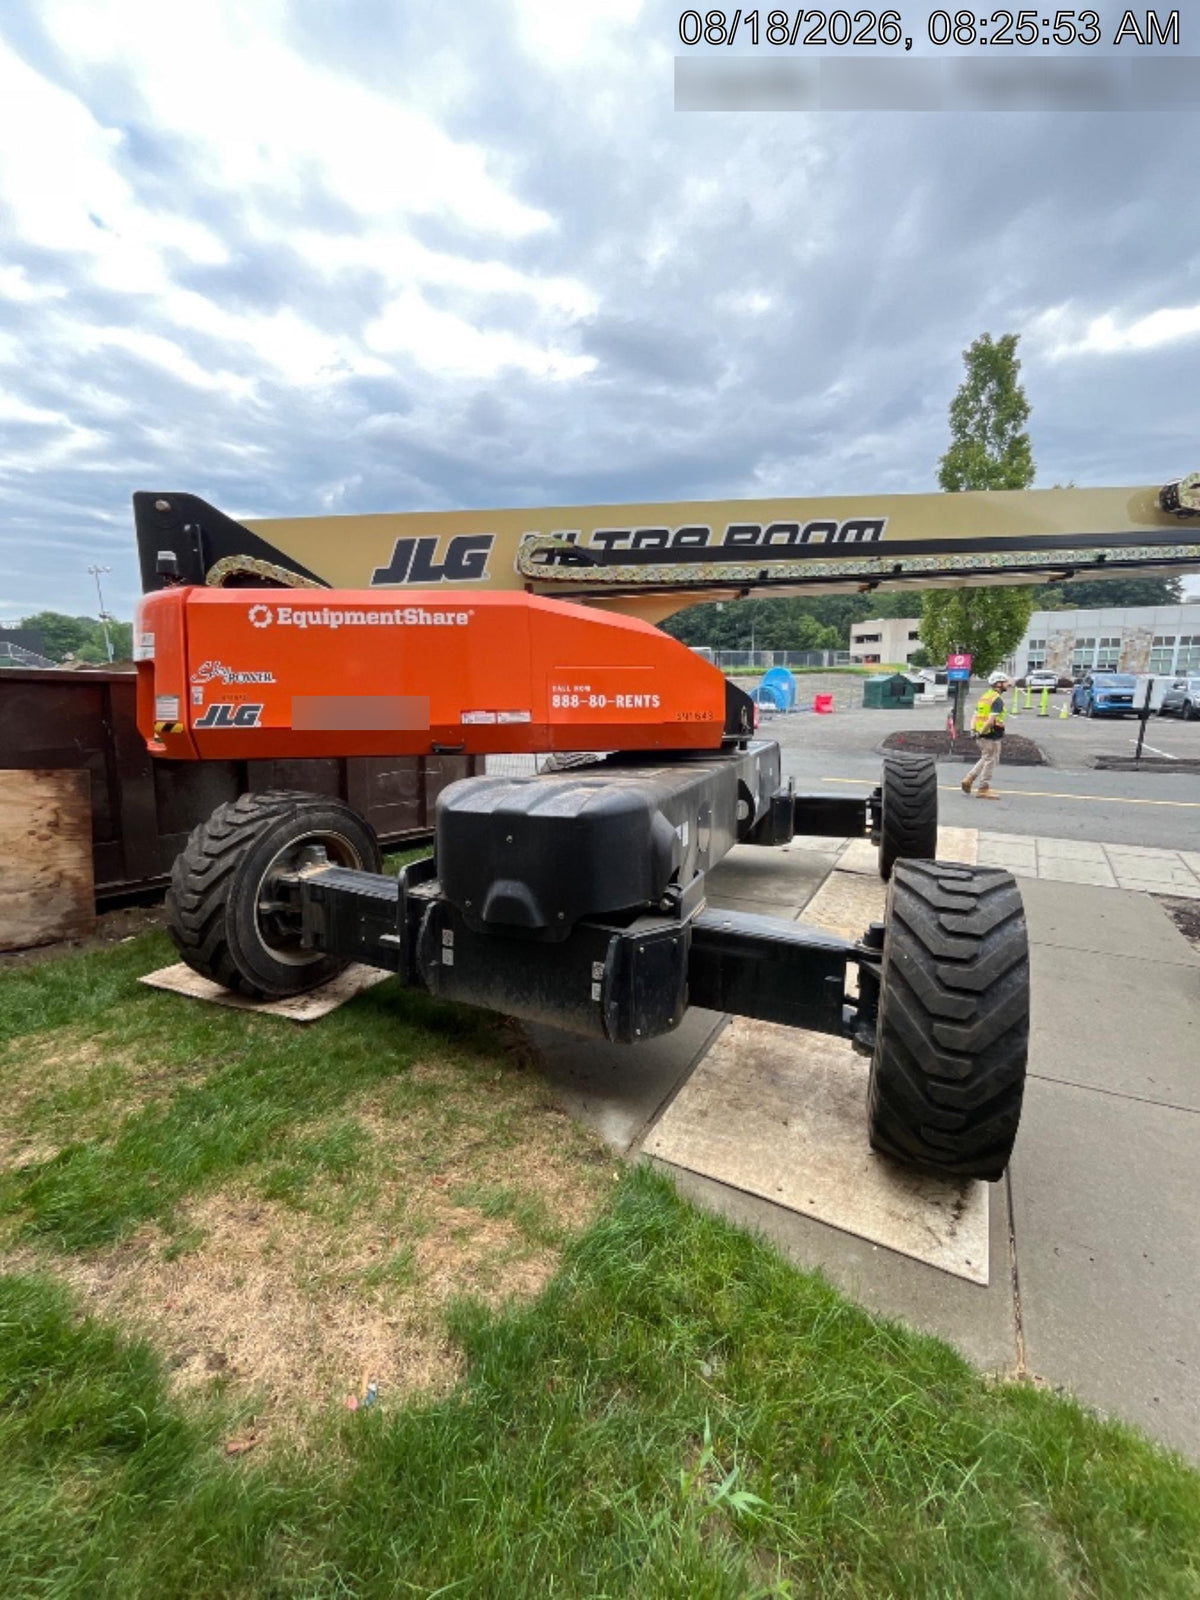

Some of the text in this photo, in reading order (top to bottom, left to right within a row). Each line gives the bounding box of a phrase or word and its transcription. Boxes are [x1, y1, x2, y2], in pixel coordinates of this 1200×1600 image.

[370, 534, 496, 586] JLG
[276, 607, 470, 629] EquipmentShare
[552, 693, 661, 709] 888-80-RENTS
[193, 704, 263, 729] JLG
